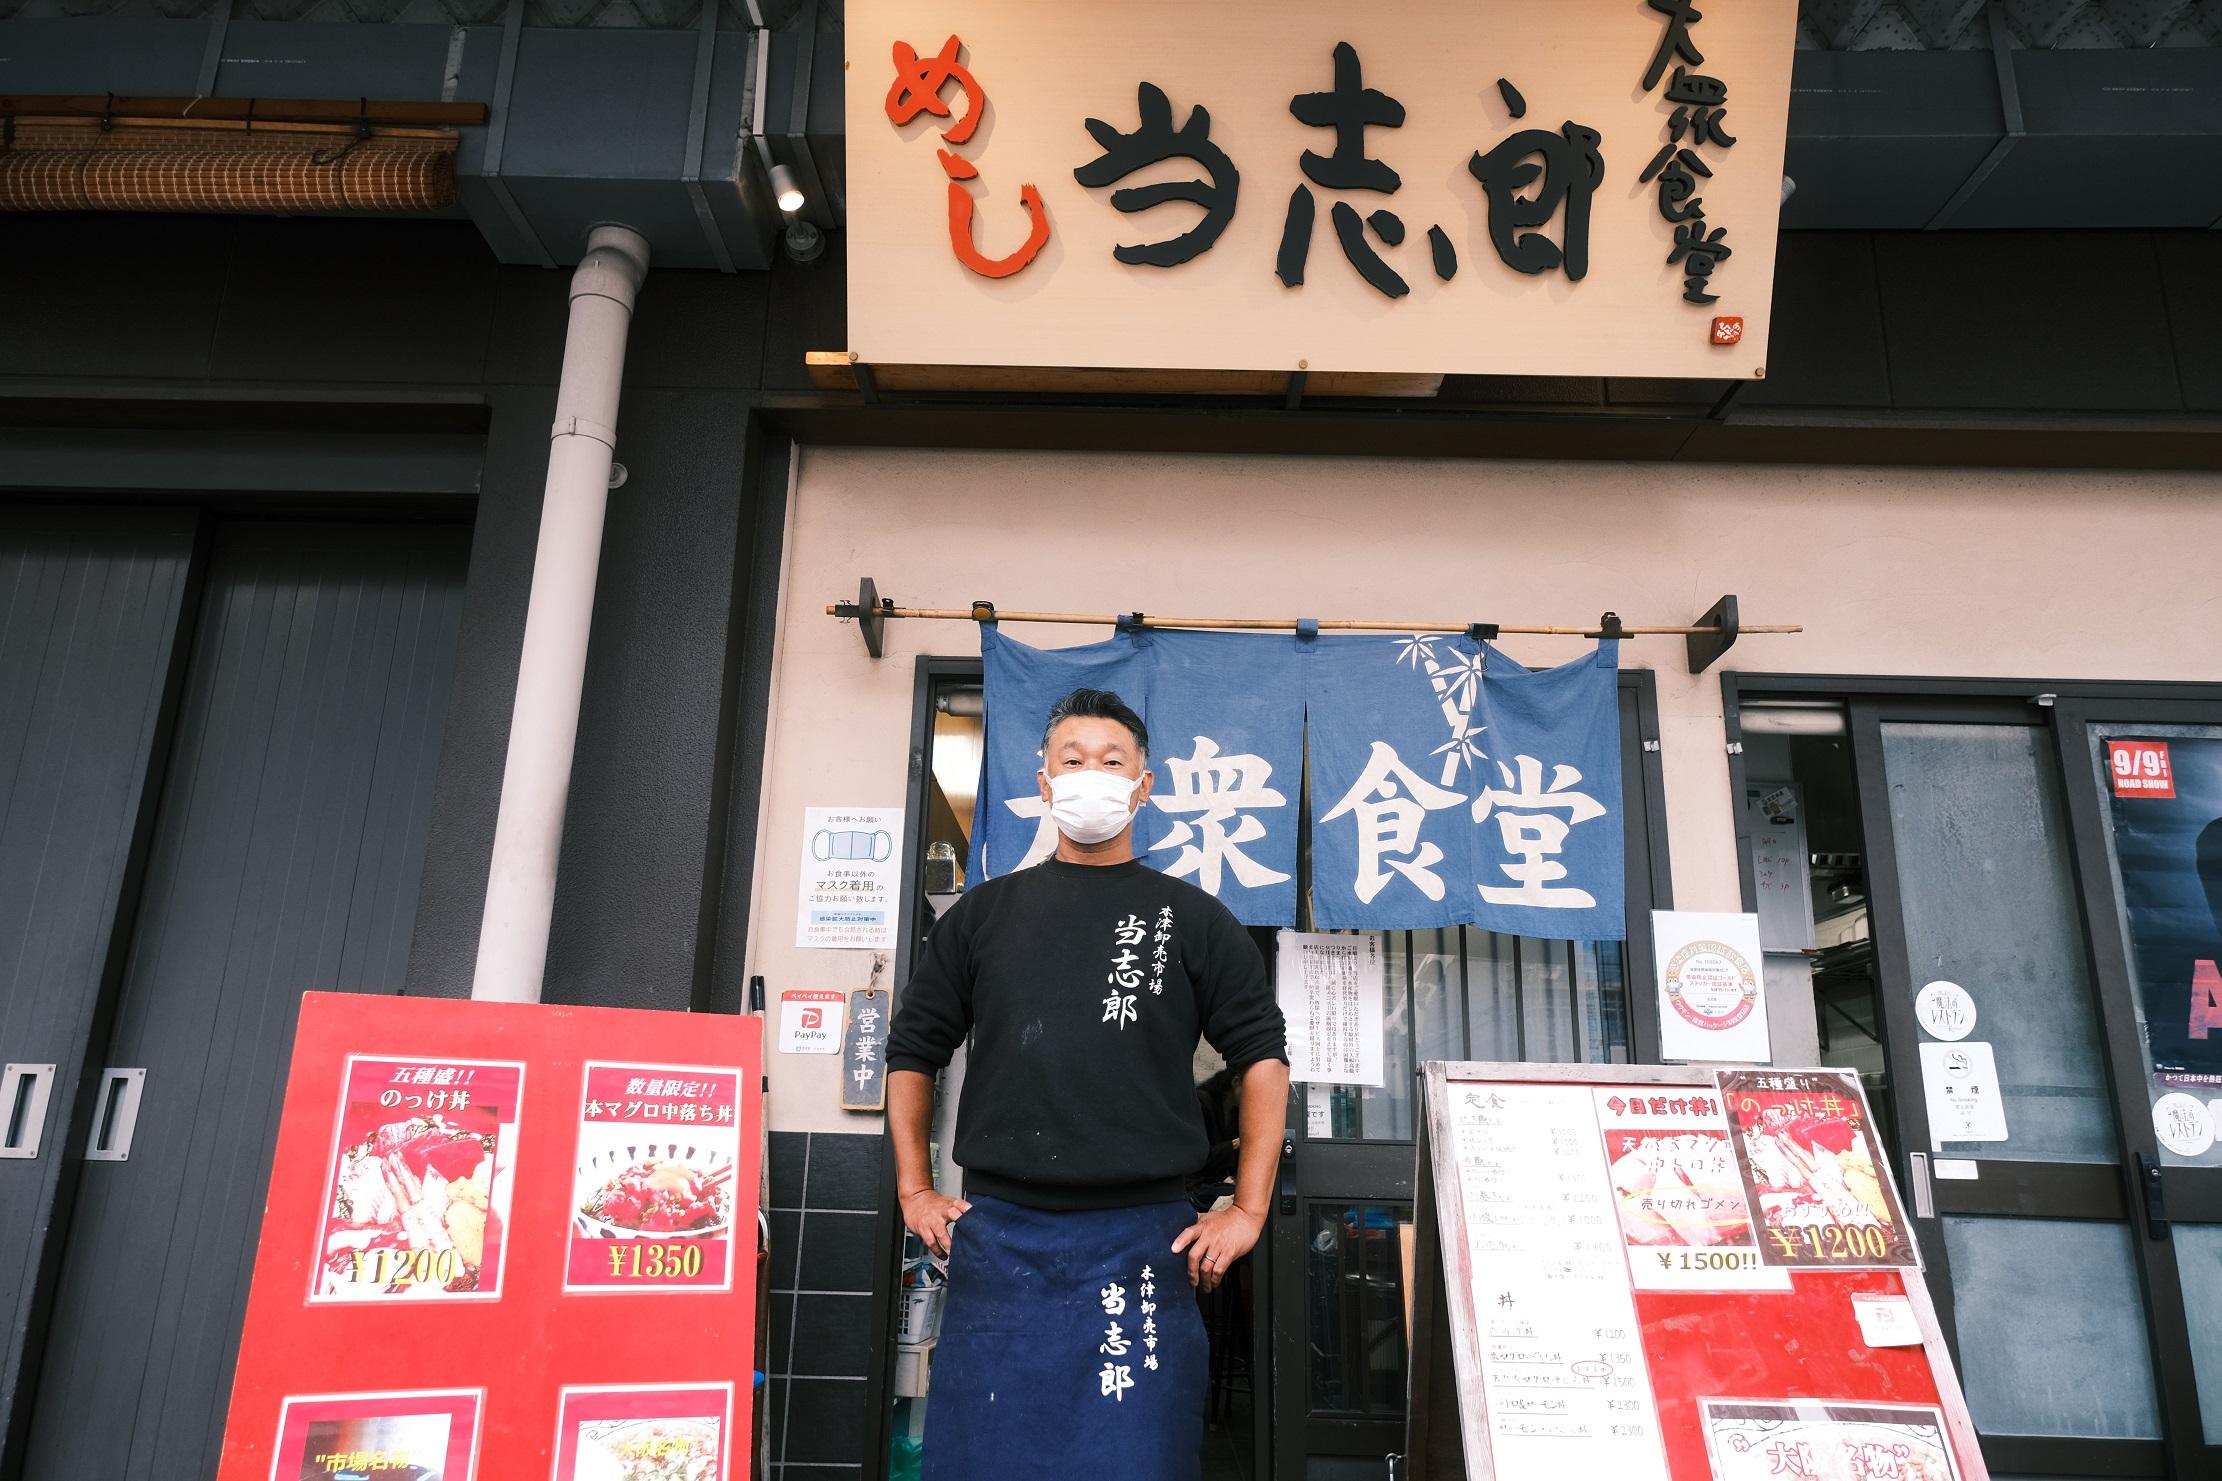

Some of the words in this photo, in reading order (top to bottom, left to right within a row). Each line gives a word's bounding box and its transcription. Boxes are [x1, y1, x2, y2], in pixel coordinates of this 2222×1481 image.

[884, 33, 1050, 279] めし
[1073, 40, 1605, 299] 当志郎
[2117, 778, 2142, 789] ROAD
[2142, 778, 2169, 789] SHOW
[1102, 914, 1147, 1031] 当志郎
[794, 1030, 827, 1041] PayPay
[852, 1007, 882, 1091] 営業中
[389, 1066, 476, 1085] 五種盛!!
[624, 1077, 717, 1098] 数量限定!!
[379, 1089, 471, 1112] のっけ丼
[584, 1099, 735, 1123] 本マグロ中落ち丼
[1464, 1092, 1506, 1109] 定食
[1640, 1197, 1742, 1211] 売り切れゴメン
[1768, 1223, 1888, 1260] ¥1200
[347, 1248, 457, 1285] ¥1200
[608, 1243, 704, 1278] ¥1350
[1498, 1292, 1515, 1309] 丼
[1098, 1282, 1135, 1402] 当志郎
[1600, 1353, 1632, 1364] ¥1350
[1607, 1399, 1640, 1411] ¥2300
